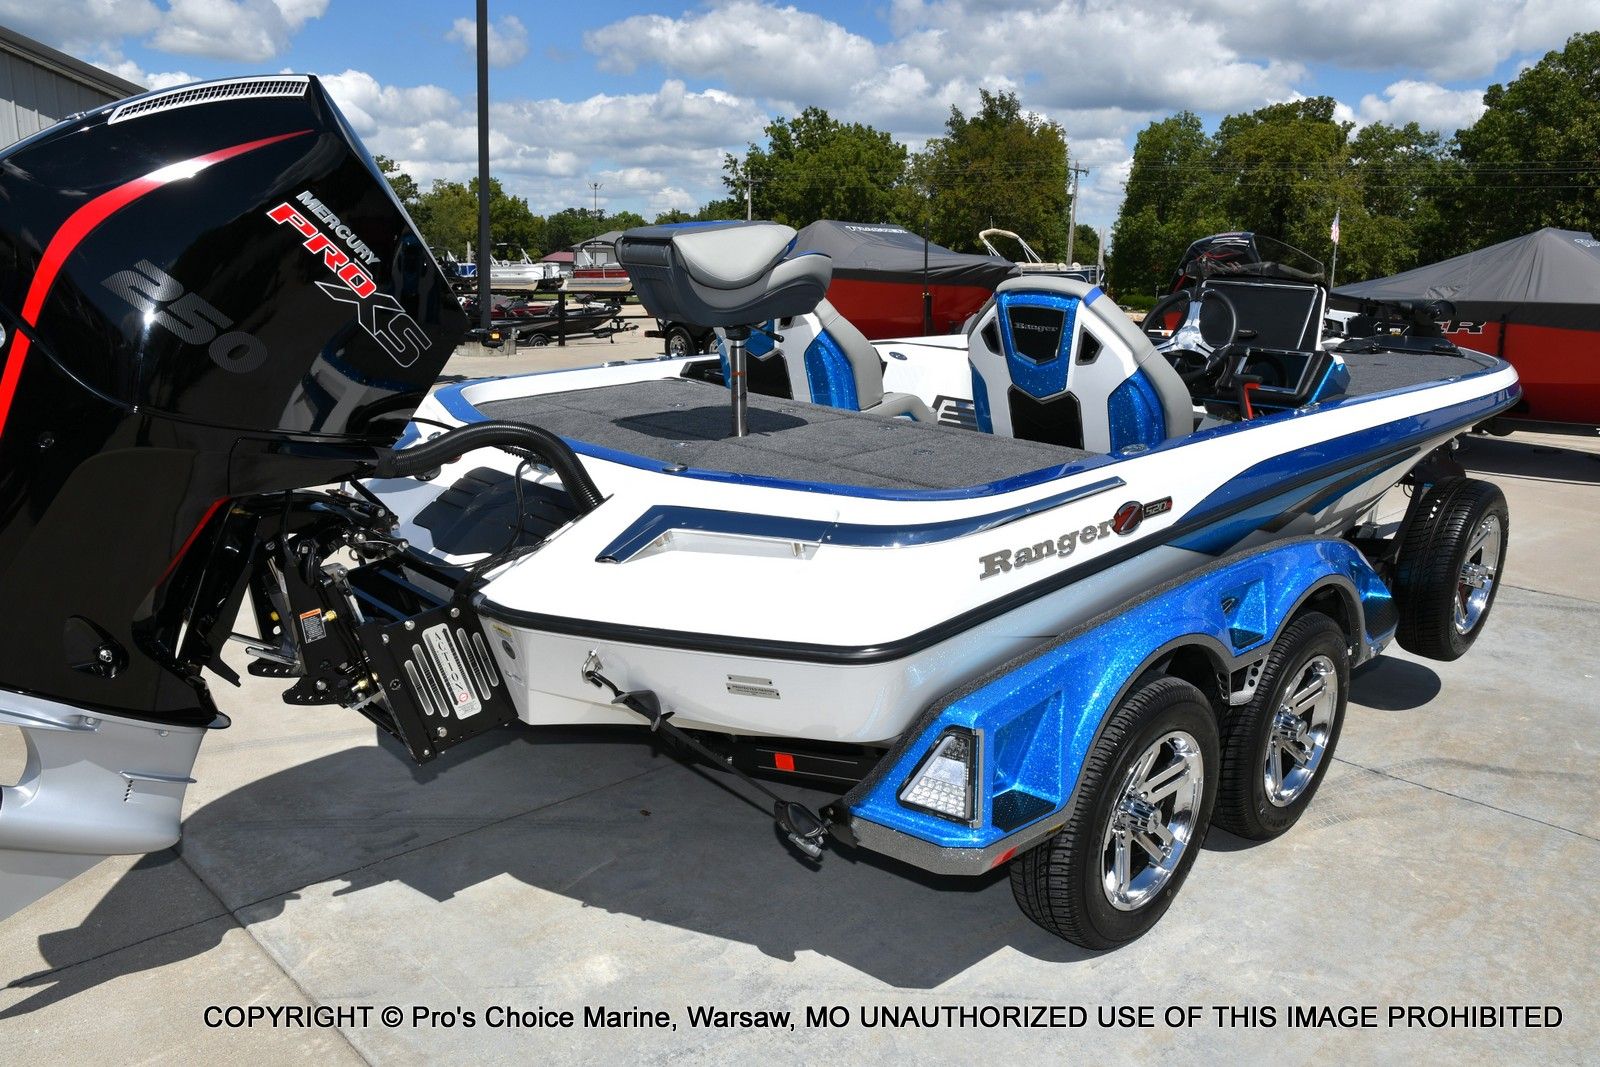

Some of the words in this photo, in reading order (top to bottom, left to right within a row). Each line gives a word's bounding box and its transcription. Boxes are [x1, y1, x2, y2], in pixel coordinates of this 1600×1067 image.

[265, 202, 377, 298] PRO
[296, 190, 381, 266] MERCURY
[100, 259, 268, 373] 250
[314, 258, 432, 368] XS
[978, 519, 1116, 579] Ranger
